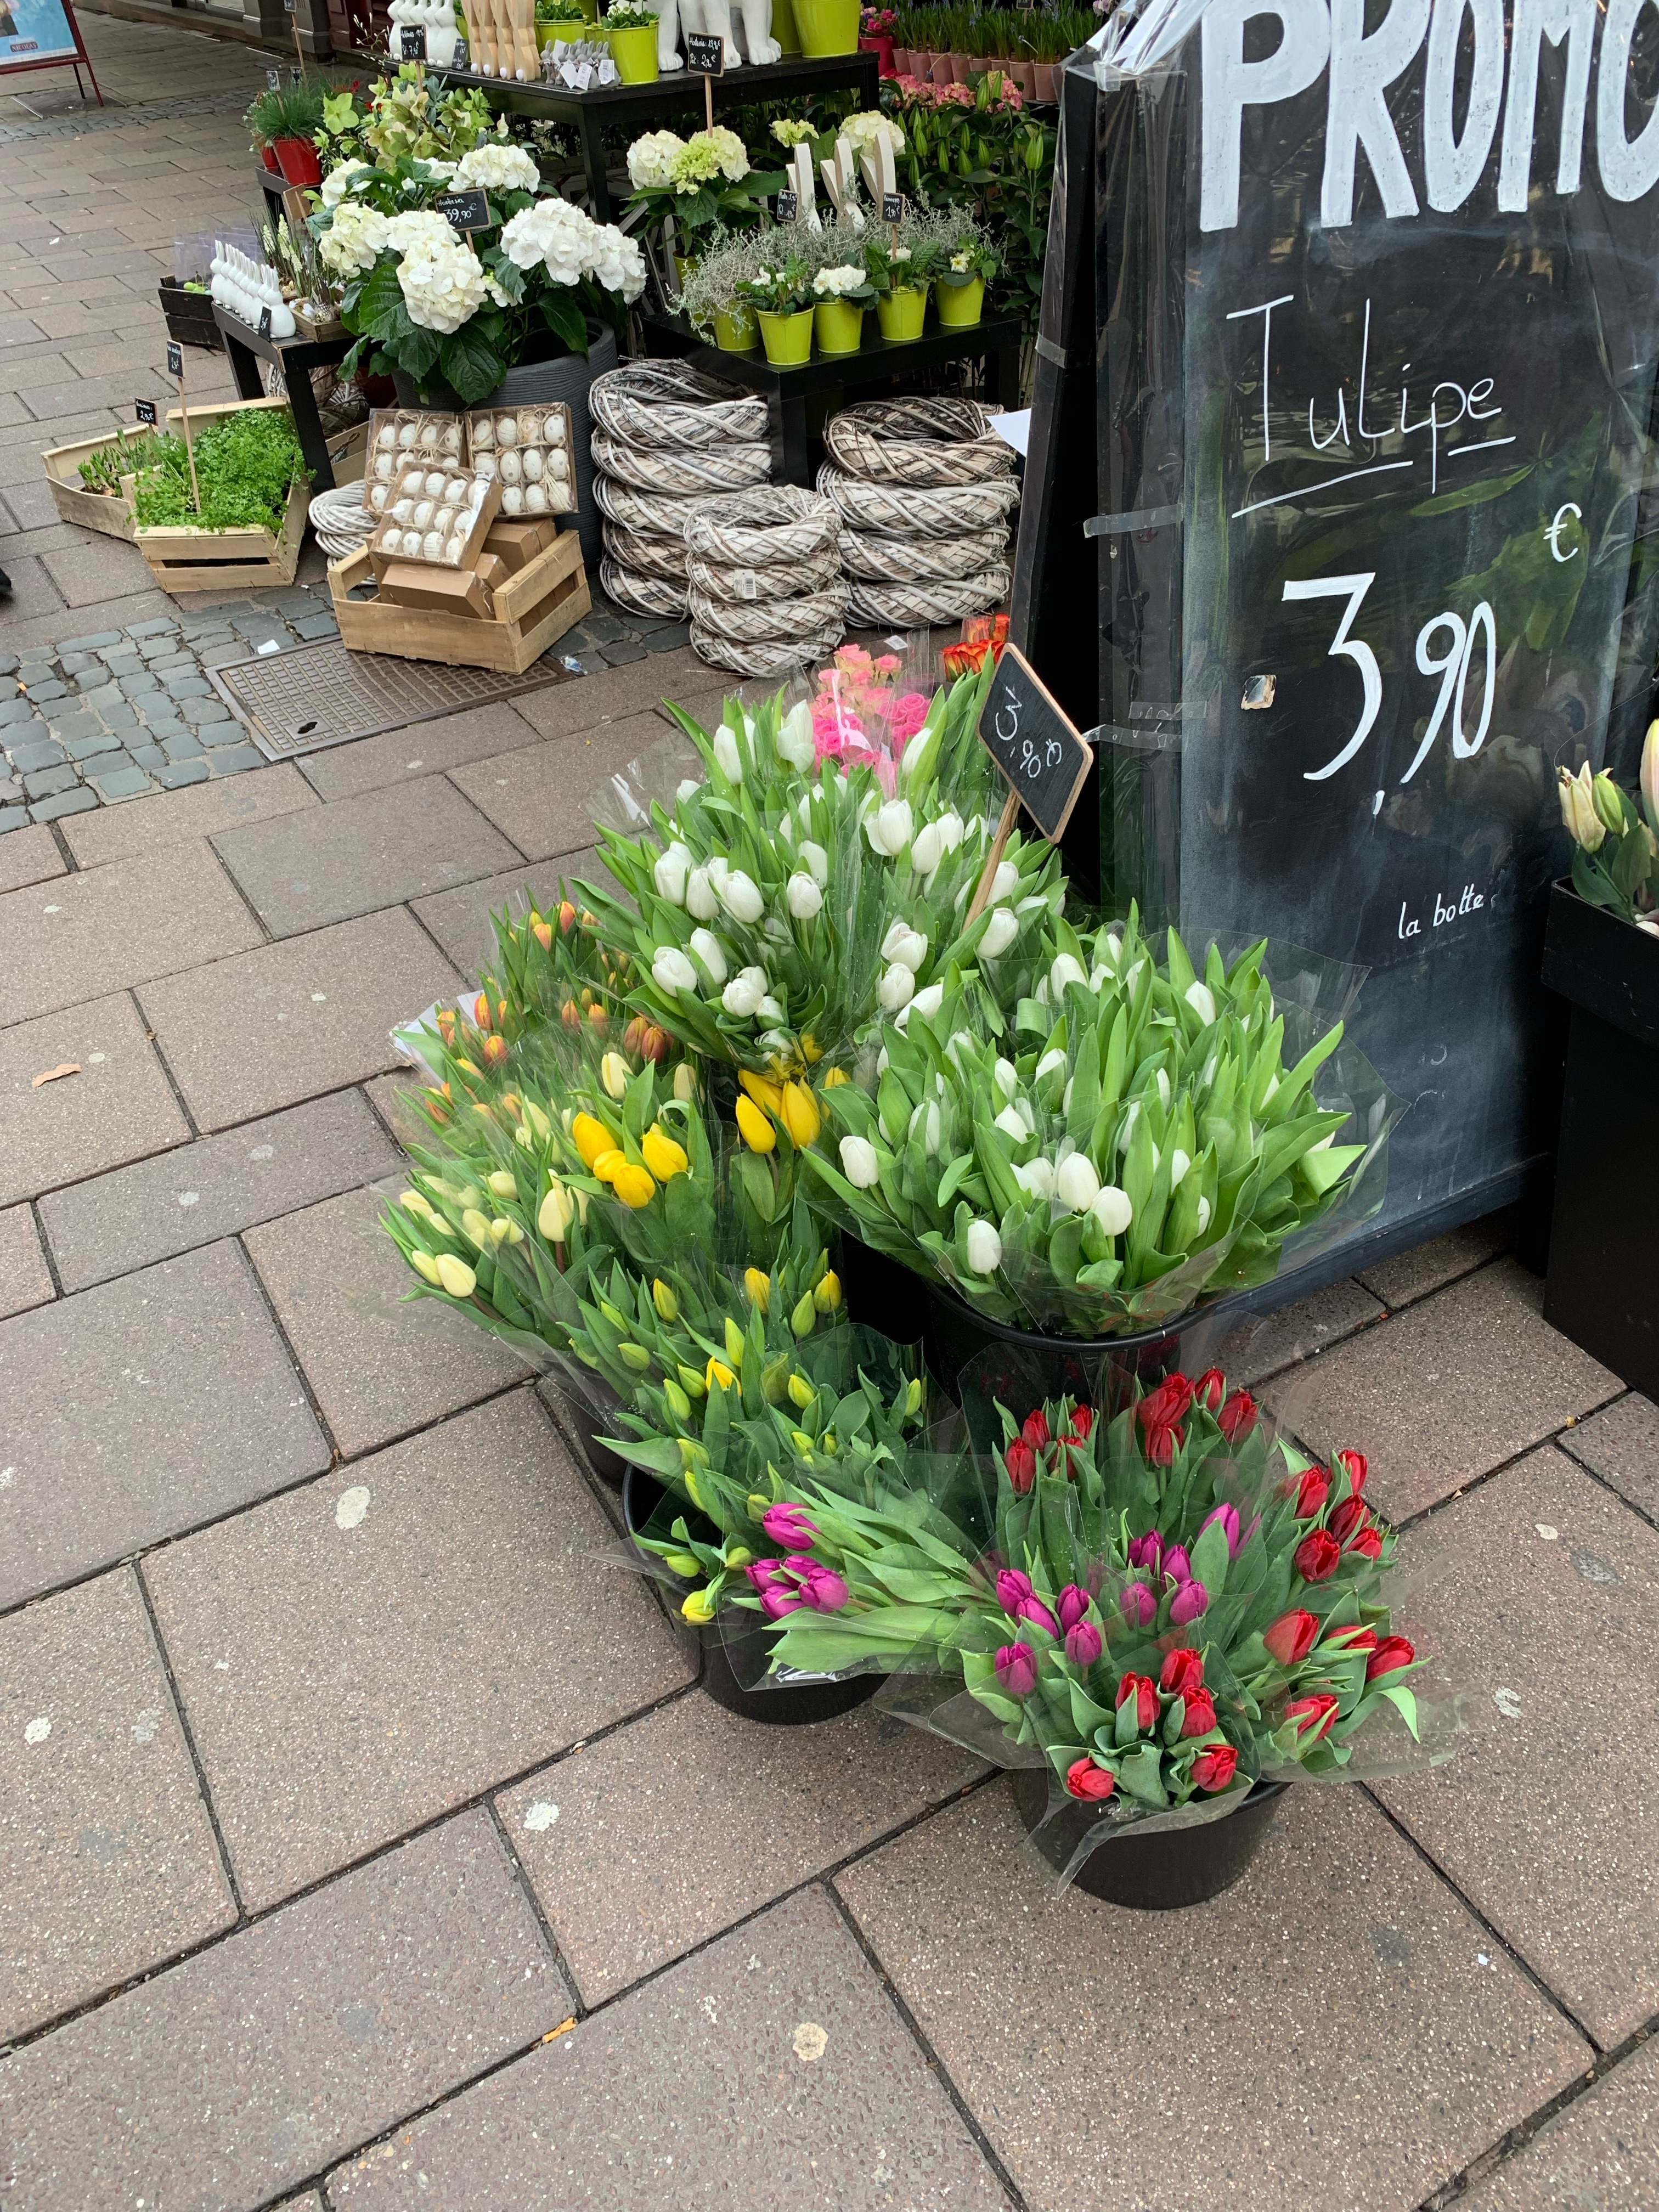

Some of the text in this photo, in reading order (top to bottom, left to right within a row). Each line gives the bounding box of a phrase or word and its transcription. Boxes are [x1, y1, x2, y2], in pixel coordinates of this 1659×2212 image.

[1281, 503, 1582, 815] 3,90 €
[1398, 883, 1484, 939] la botte
